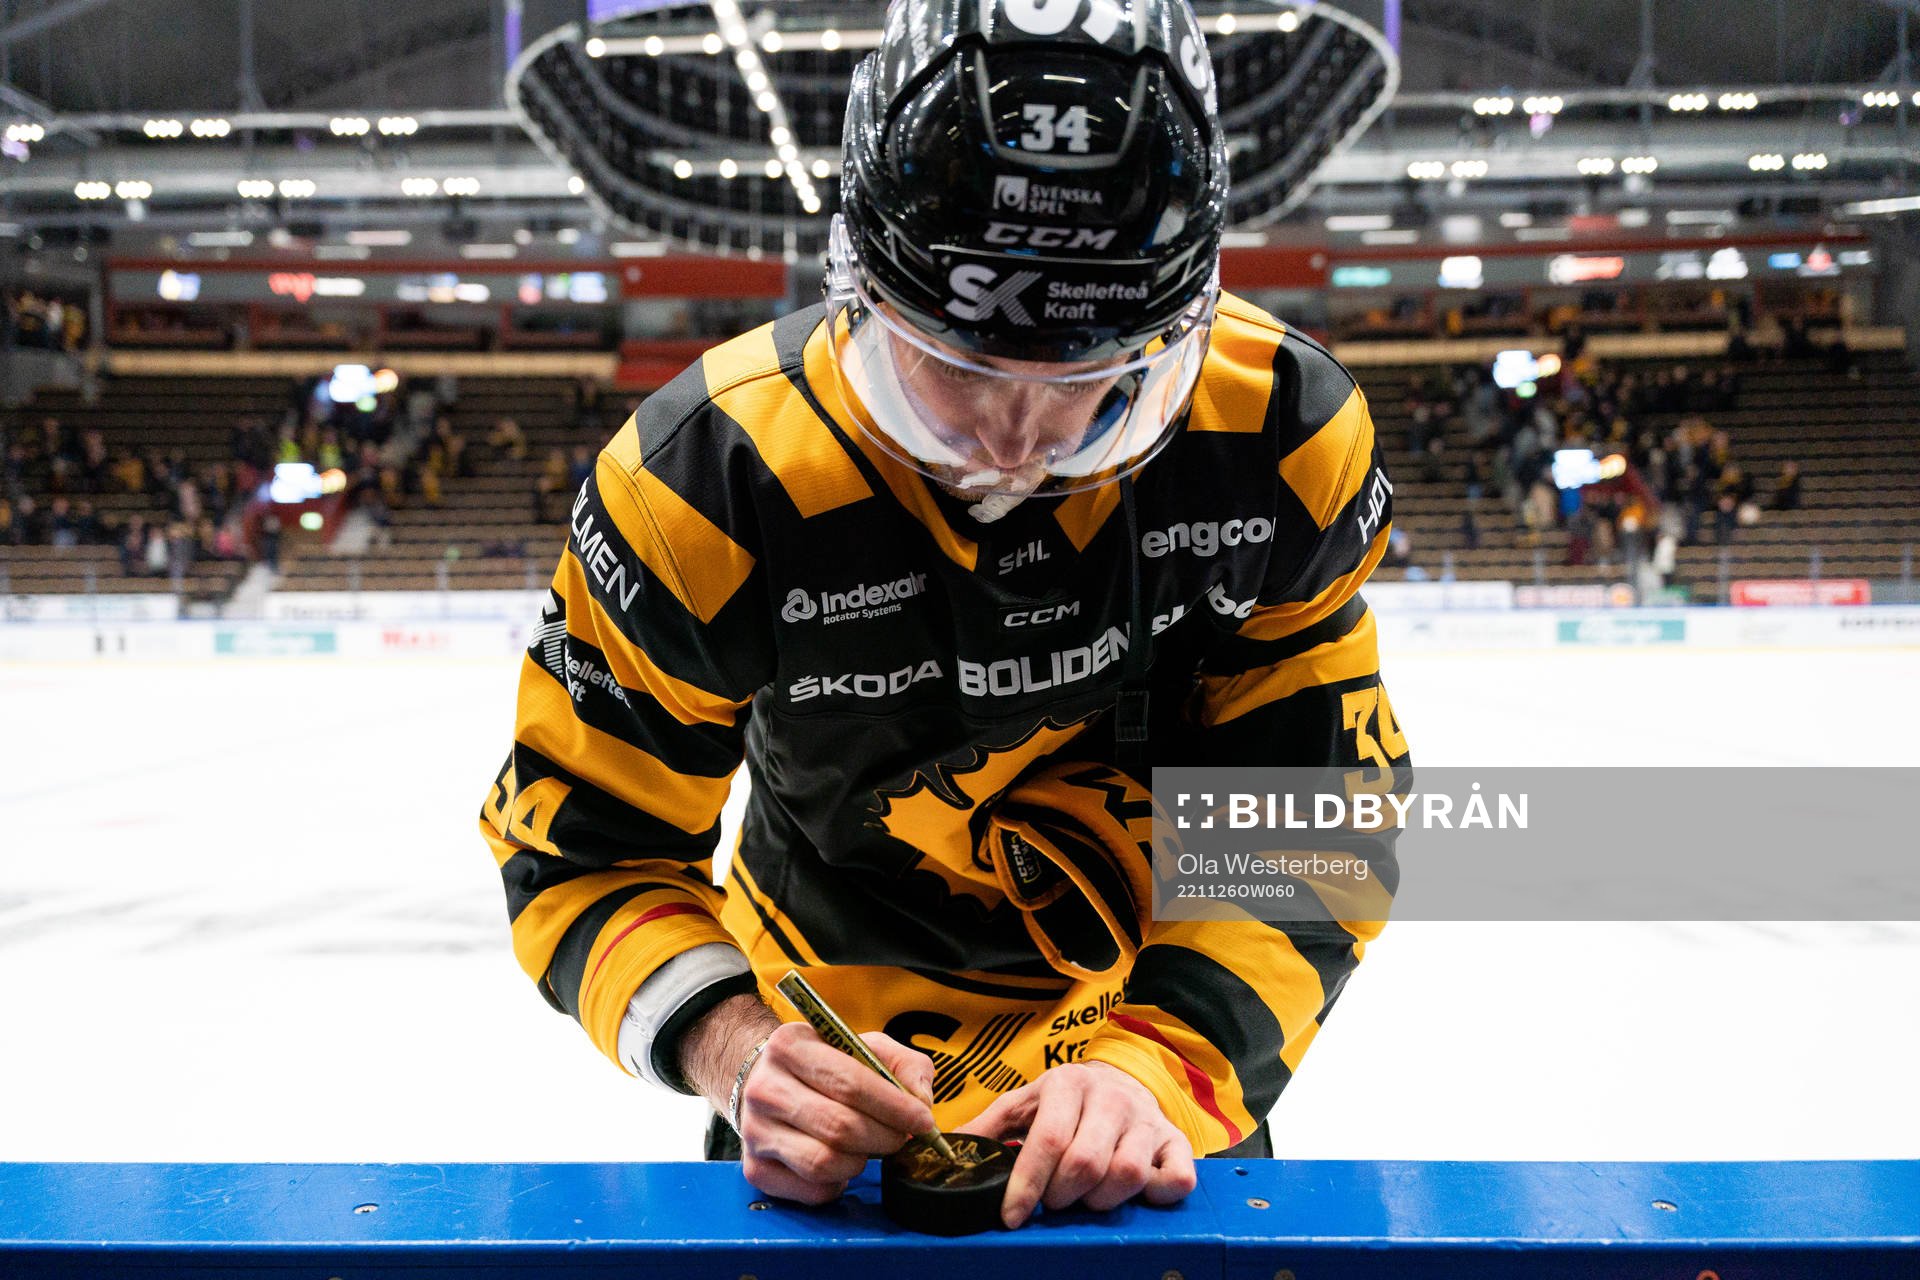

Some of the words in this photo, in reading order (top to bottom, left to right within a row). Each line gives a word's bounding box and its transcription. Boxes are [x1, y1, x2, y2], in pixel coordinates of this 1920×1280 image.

[1020, 103, 1091, 153] 34
[1028, 200, 1067, 216] SPEL
[1029, 184, 1102, 205] SVENSKA
[983, 221, 1117, 250] CCM
[1047, 280, 1149, 300] Skellefteå
[1044, 300, 1096, 319] Kraft
[571, 476, 641, 613] OLMEN
[1141, 516, 1277, 558] engco
[998, 539, 1052, 576] SHL
[821, 571, 928, 615] Indexair
[823, 610, 860, 626] Rotator
[862, 602, 903, 620] Systems
[1003, 600, 1081, 628] CCM
[957, 621, 1131, 697] BOLIDEN
[789, 659, 944, 703] ŠKODA
[1341, 682, 1409, 803] 34
